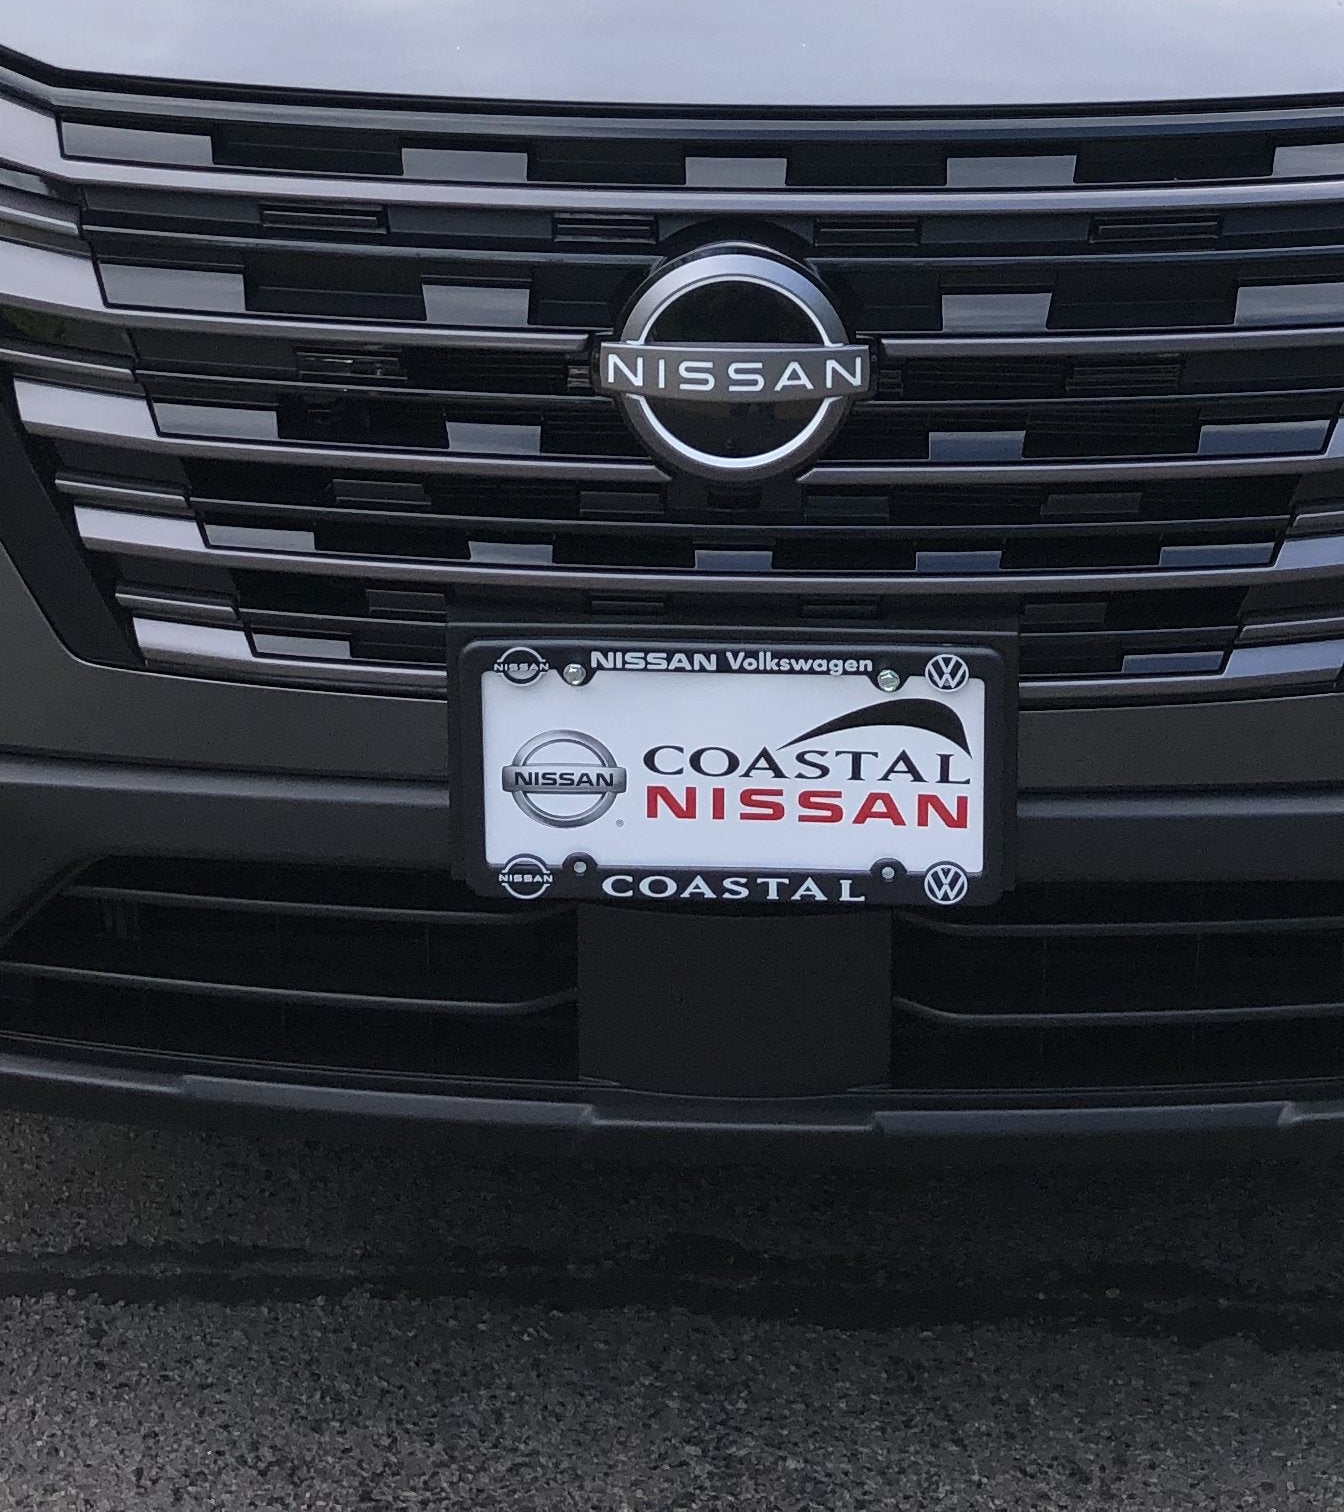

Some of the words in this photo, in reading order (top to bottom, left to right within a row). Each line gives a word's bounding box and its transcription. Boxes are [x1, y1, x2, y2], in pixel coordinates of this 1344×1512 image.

[607, 353, 862, 392] NISSAN
[493, 661, 549, 672] NISSAN
[590, 651, 717, 671] NISSAN
[725, 651, 873, 676] Volkswagen
[643, 745, 971, 785] COASTAL
[514, 771, 614, 787] NISSAN
[646, 785, 968, 828] NISSAN
[498, 872, 553, 883] NISSAN
[602, 874, 865, 902] COASTAL
